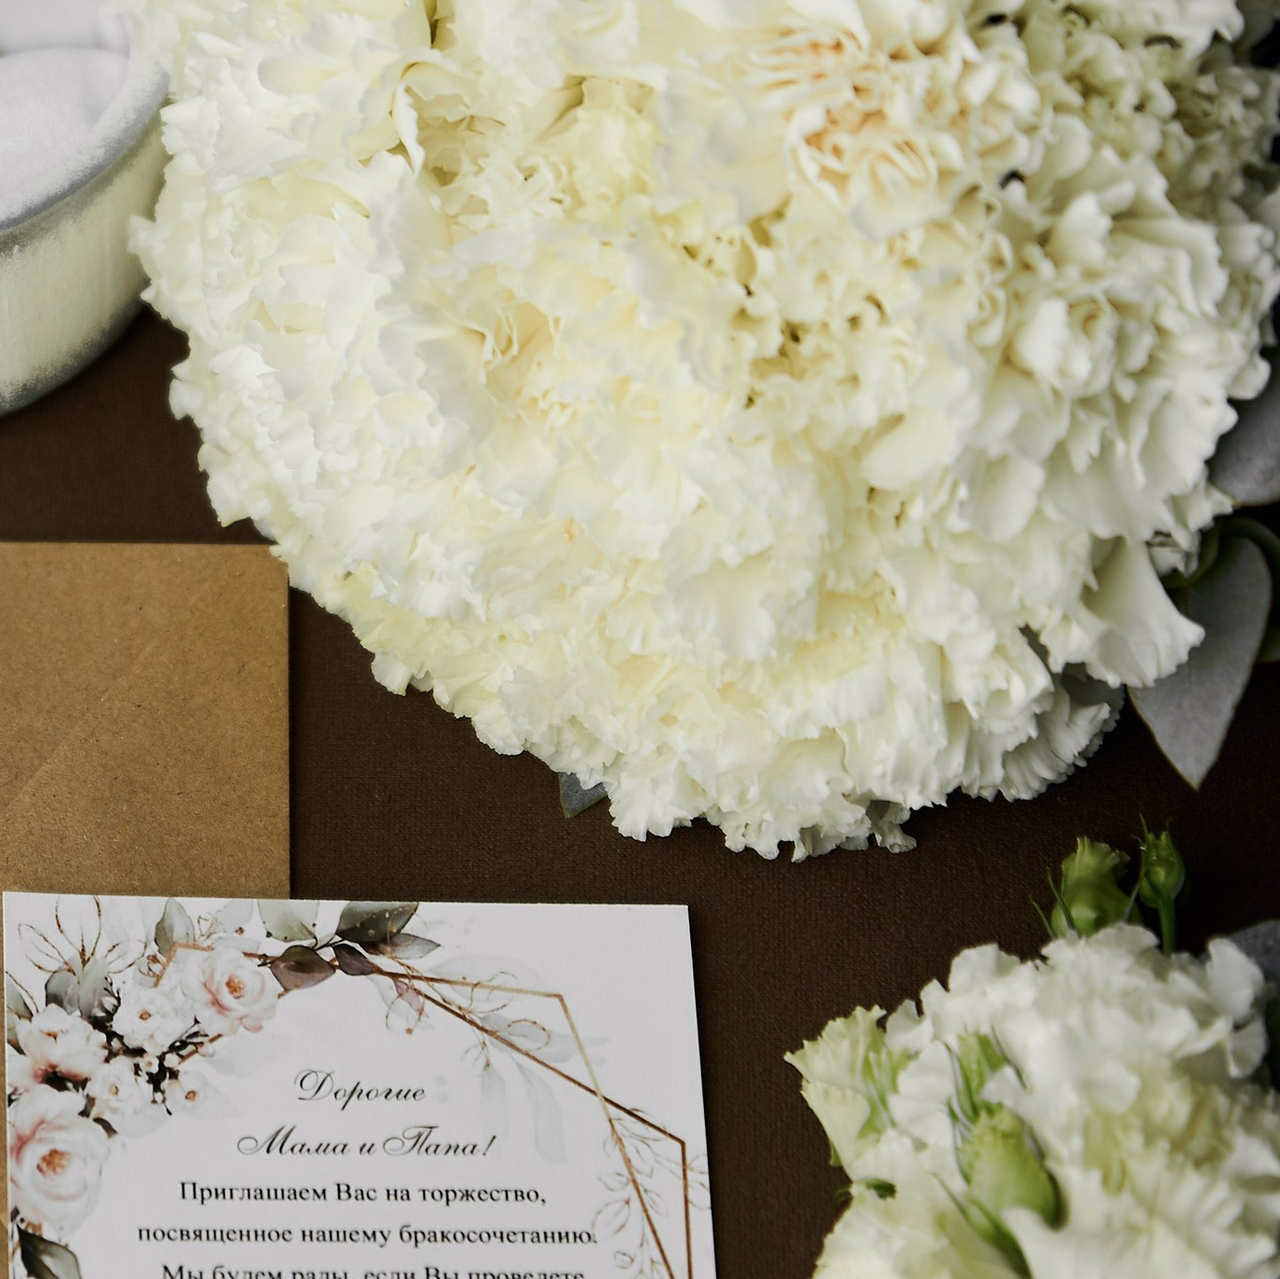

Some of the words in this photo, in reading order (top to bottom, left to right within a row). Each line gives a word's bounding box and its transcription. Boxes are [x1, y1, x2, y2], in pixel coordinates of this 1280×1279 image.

[293, 1068, 426, 1112] Дорогие
[236, 1124, 352, 1156] Мама
[358, 1139, 377, 1156] и
[382, 1124, 498, 1157] Папа!
[179, 1181, 328, 1206] Приглашаем
[335, 1182, 378, 1202] Вас
[385, 1187, 411, 1203] на
[418, 1187, 548, 1208] торжество,
[137, 1227, 294, 1245] посвященное
[300, 1229, 392, 1249] нашему
[398, 1224, 598, 1248] бракосочетанию.
